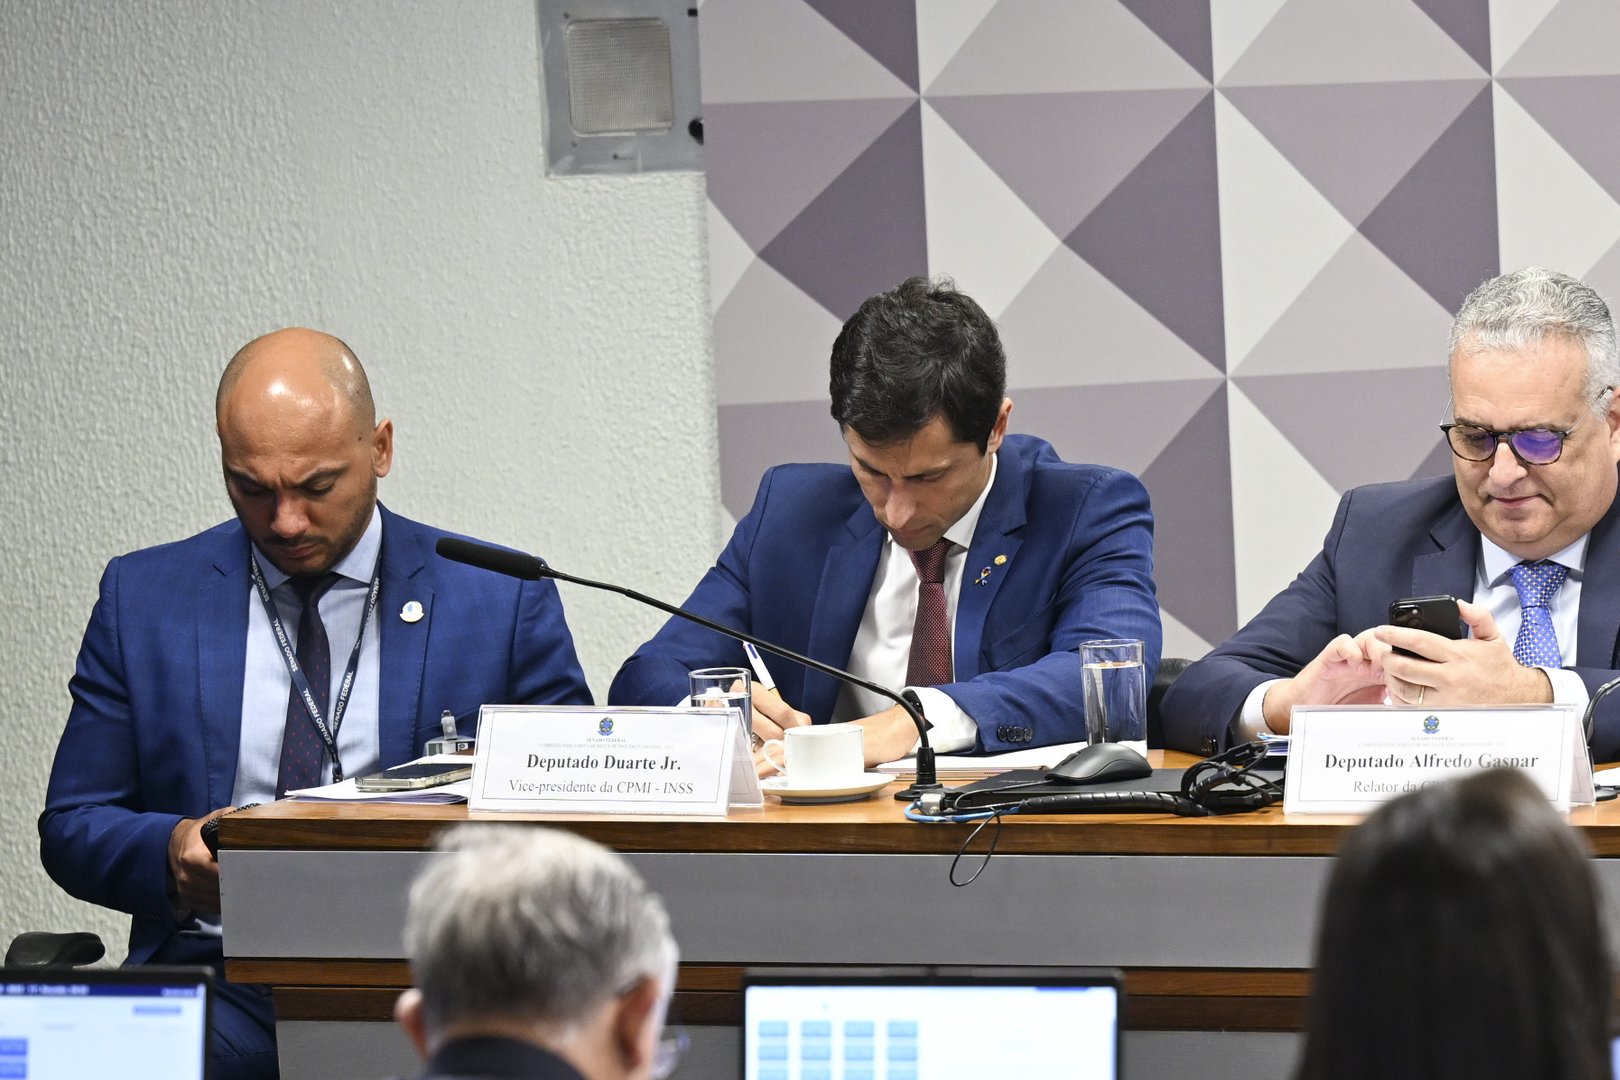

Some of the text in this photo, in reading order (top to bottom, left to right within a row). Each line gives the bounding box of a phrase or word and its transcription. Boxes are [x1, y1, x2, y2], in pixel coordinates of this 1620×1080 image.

[256, 576, 270, 602] SENADO
[273, 617, 299, 672] SENADO FEDERAL
[340, 671, 353, 701] FEDERAL
[303, 687, 333, 745] SENADO FEDERAL
[527, 754, 681, 772] Deputado Duarte Jr.
[1325, 753, 1539, 772] Deputado Alfredo Gaspar
[510, 779, 596, 795] Vice-presidente
[600, 780, 613, 793] da
[617, 781, 651, 794] CPMI
[663, 782, 694, 795] INSS
[1353, 780, 1399, 793] Relator
[1402, 780, 1417, 793] da
